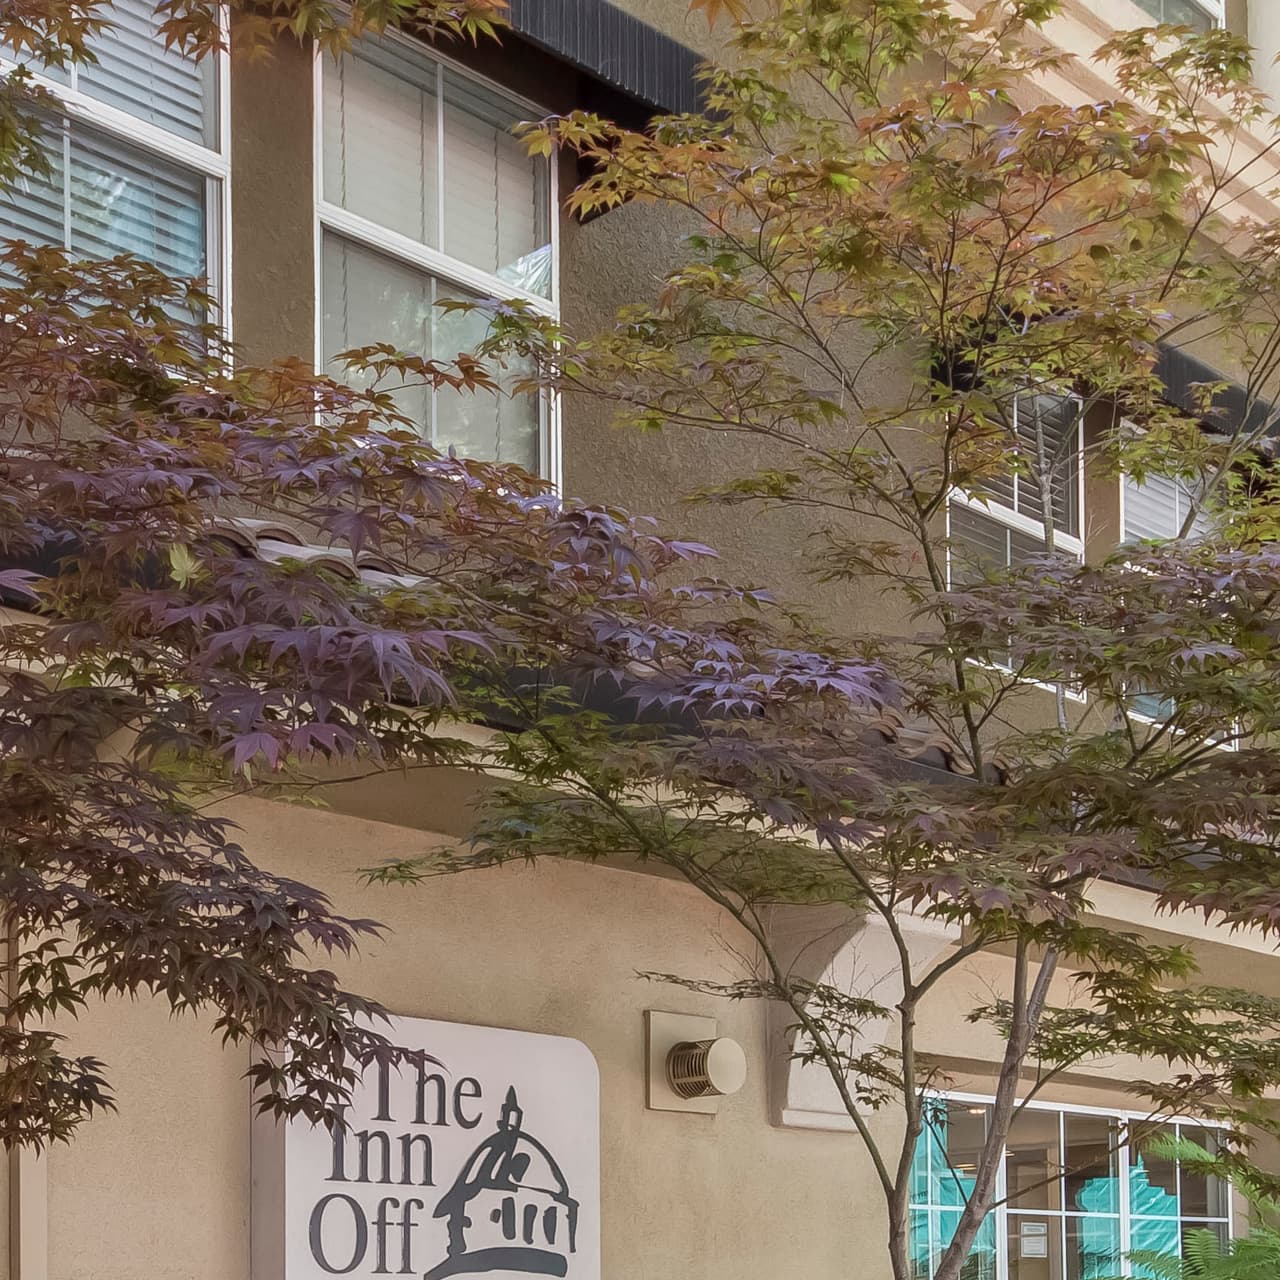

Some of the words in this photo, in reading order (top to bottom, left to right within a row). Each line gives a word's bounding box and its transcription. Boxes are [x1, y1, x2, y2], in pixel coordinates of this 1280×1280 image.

[359, 1048, 483, 1129] The
[322, 1102, 437, 1187] Inn
[308, 1193, 424, 1275] Off
